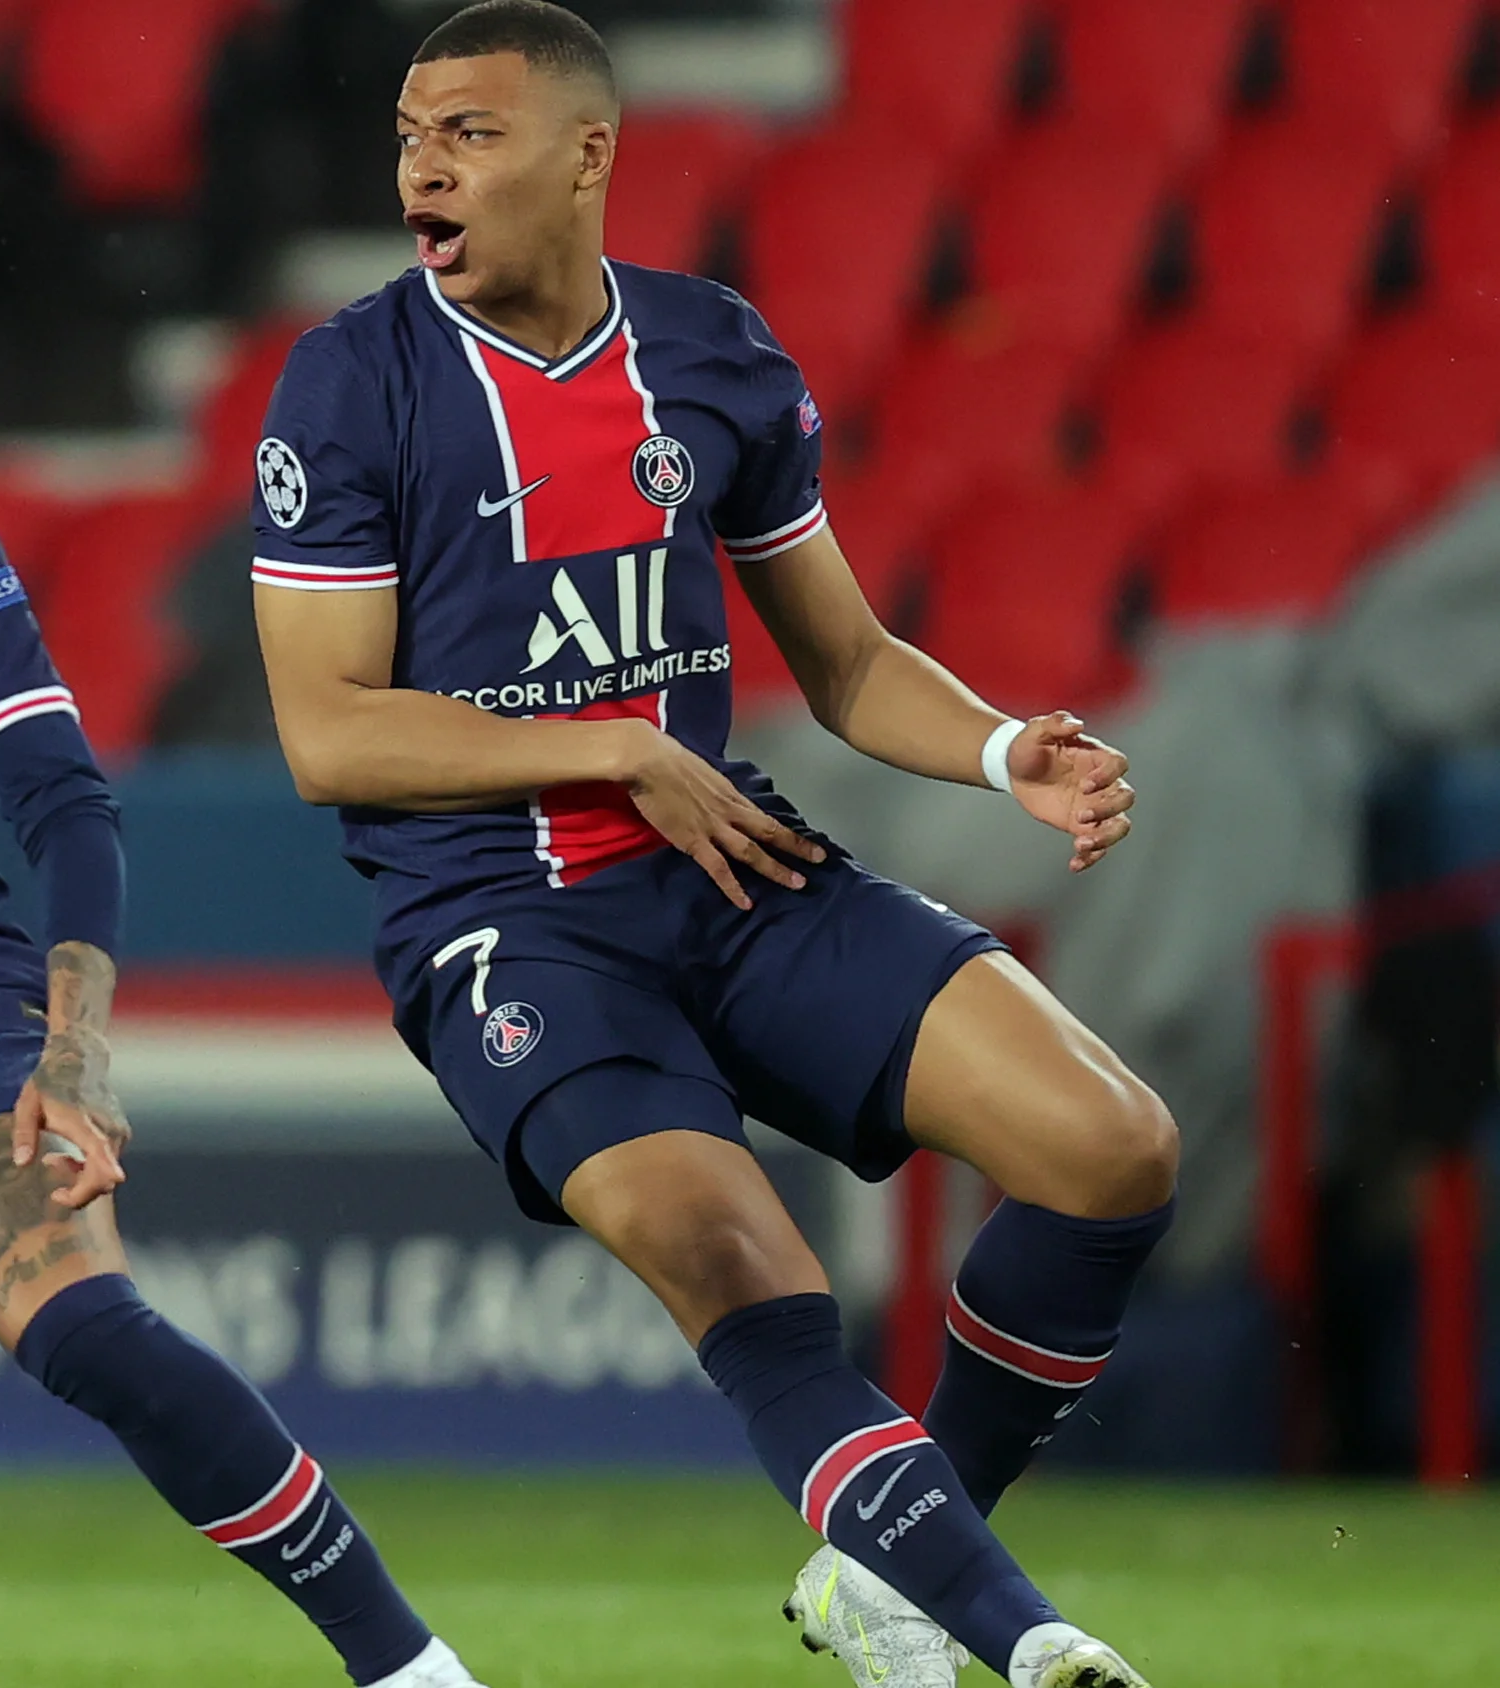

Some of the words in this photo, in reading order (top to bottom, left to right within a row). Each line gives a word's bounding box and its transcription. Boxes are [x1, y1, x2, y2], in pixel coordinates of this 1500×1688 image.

[640, 439, 680, 460] PARIS
[435, 684, 548, 711] COR
[555, 674, 616, 705] LIVE
[621, 643, 731, 693] LIMITLESS
[432, 926, 500, 1016] 7
[876, 1488, 948, 1551] PARIS
[290, 1524, 354, 1584] PARIS
